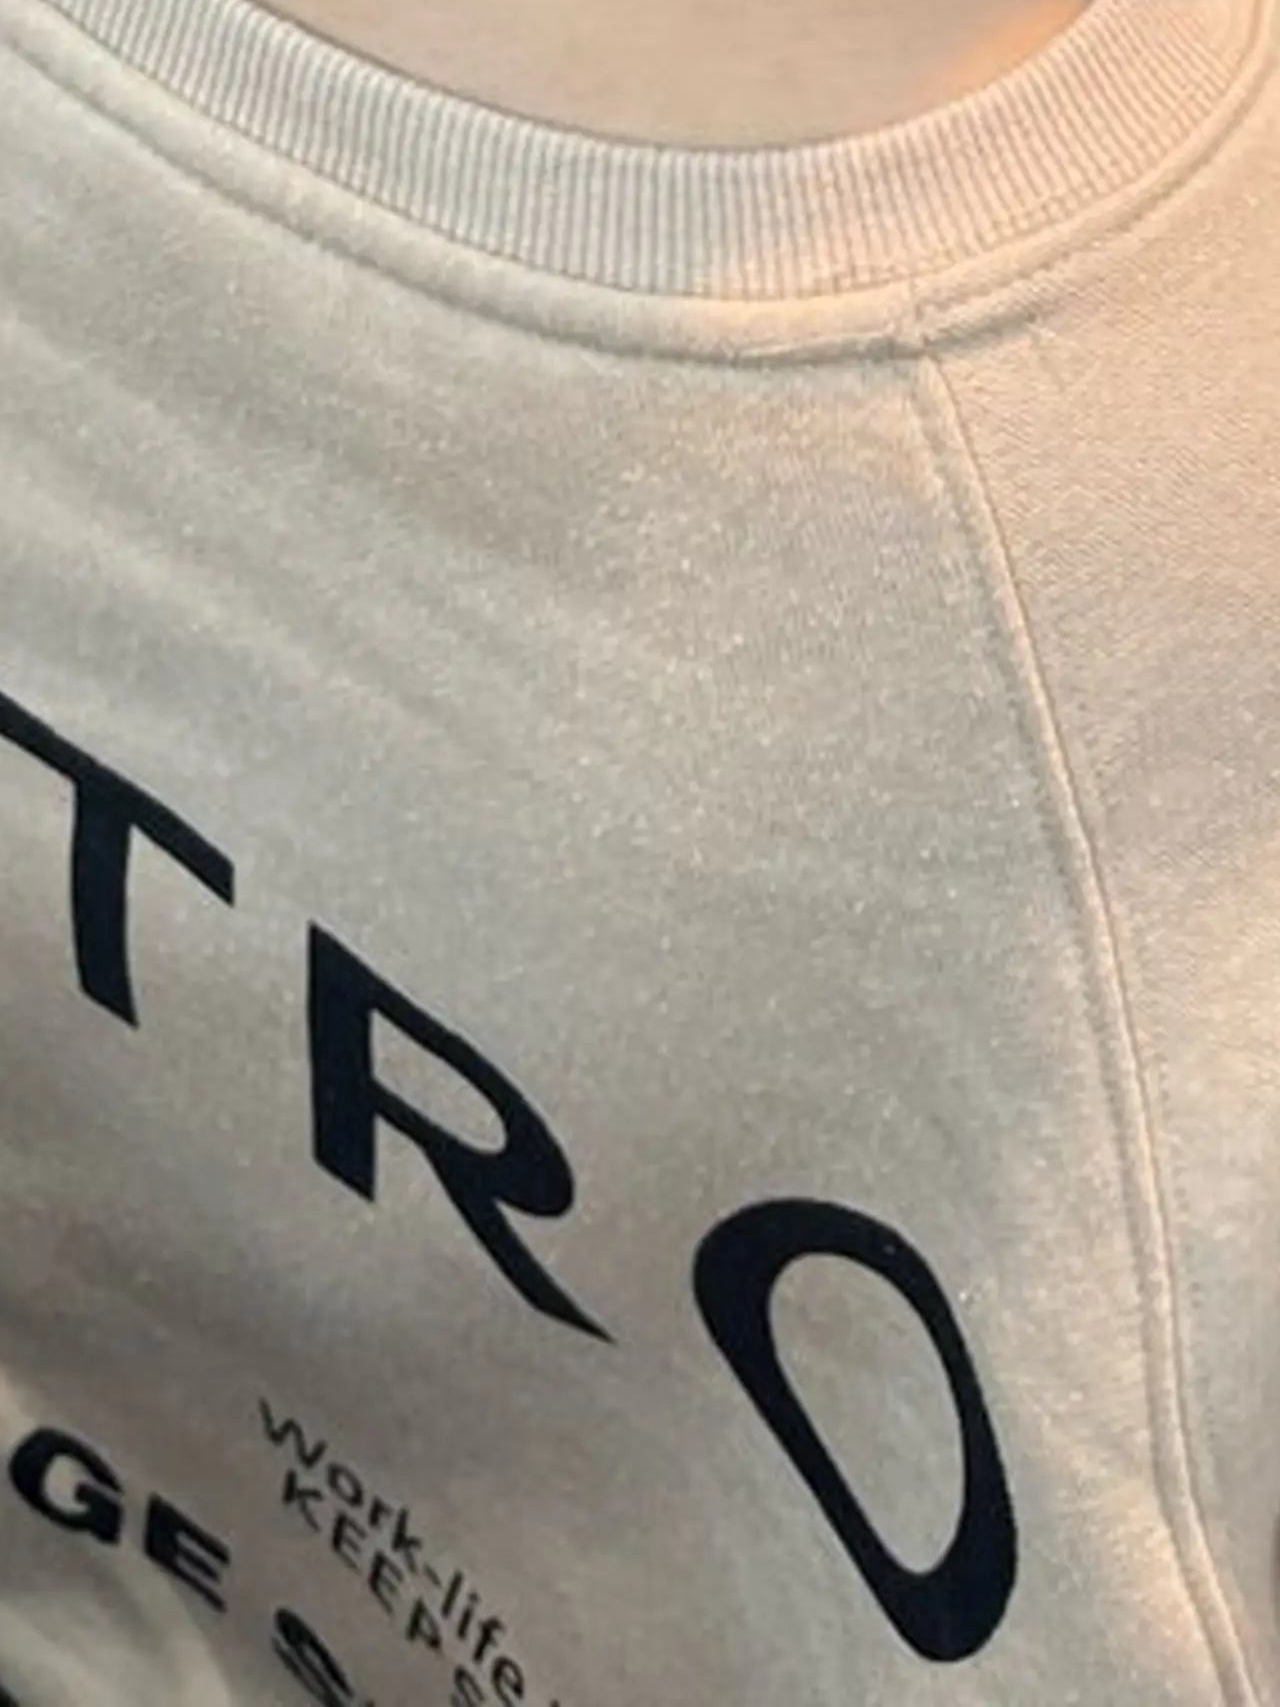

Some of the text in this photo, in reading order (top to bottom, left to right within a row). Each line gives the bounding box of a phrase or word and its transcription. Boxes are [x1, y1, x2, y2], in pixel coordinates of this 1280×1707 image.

[258, 1396, 525, 1707] Work-life
[281, 1468, 443, 1655] KEEP
[271, 1607, 377, 1707] S
